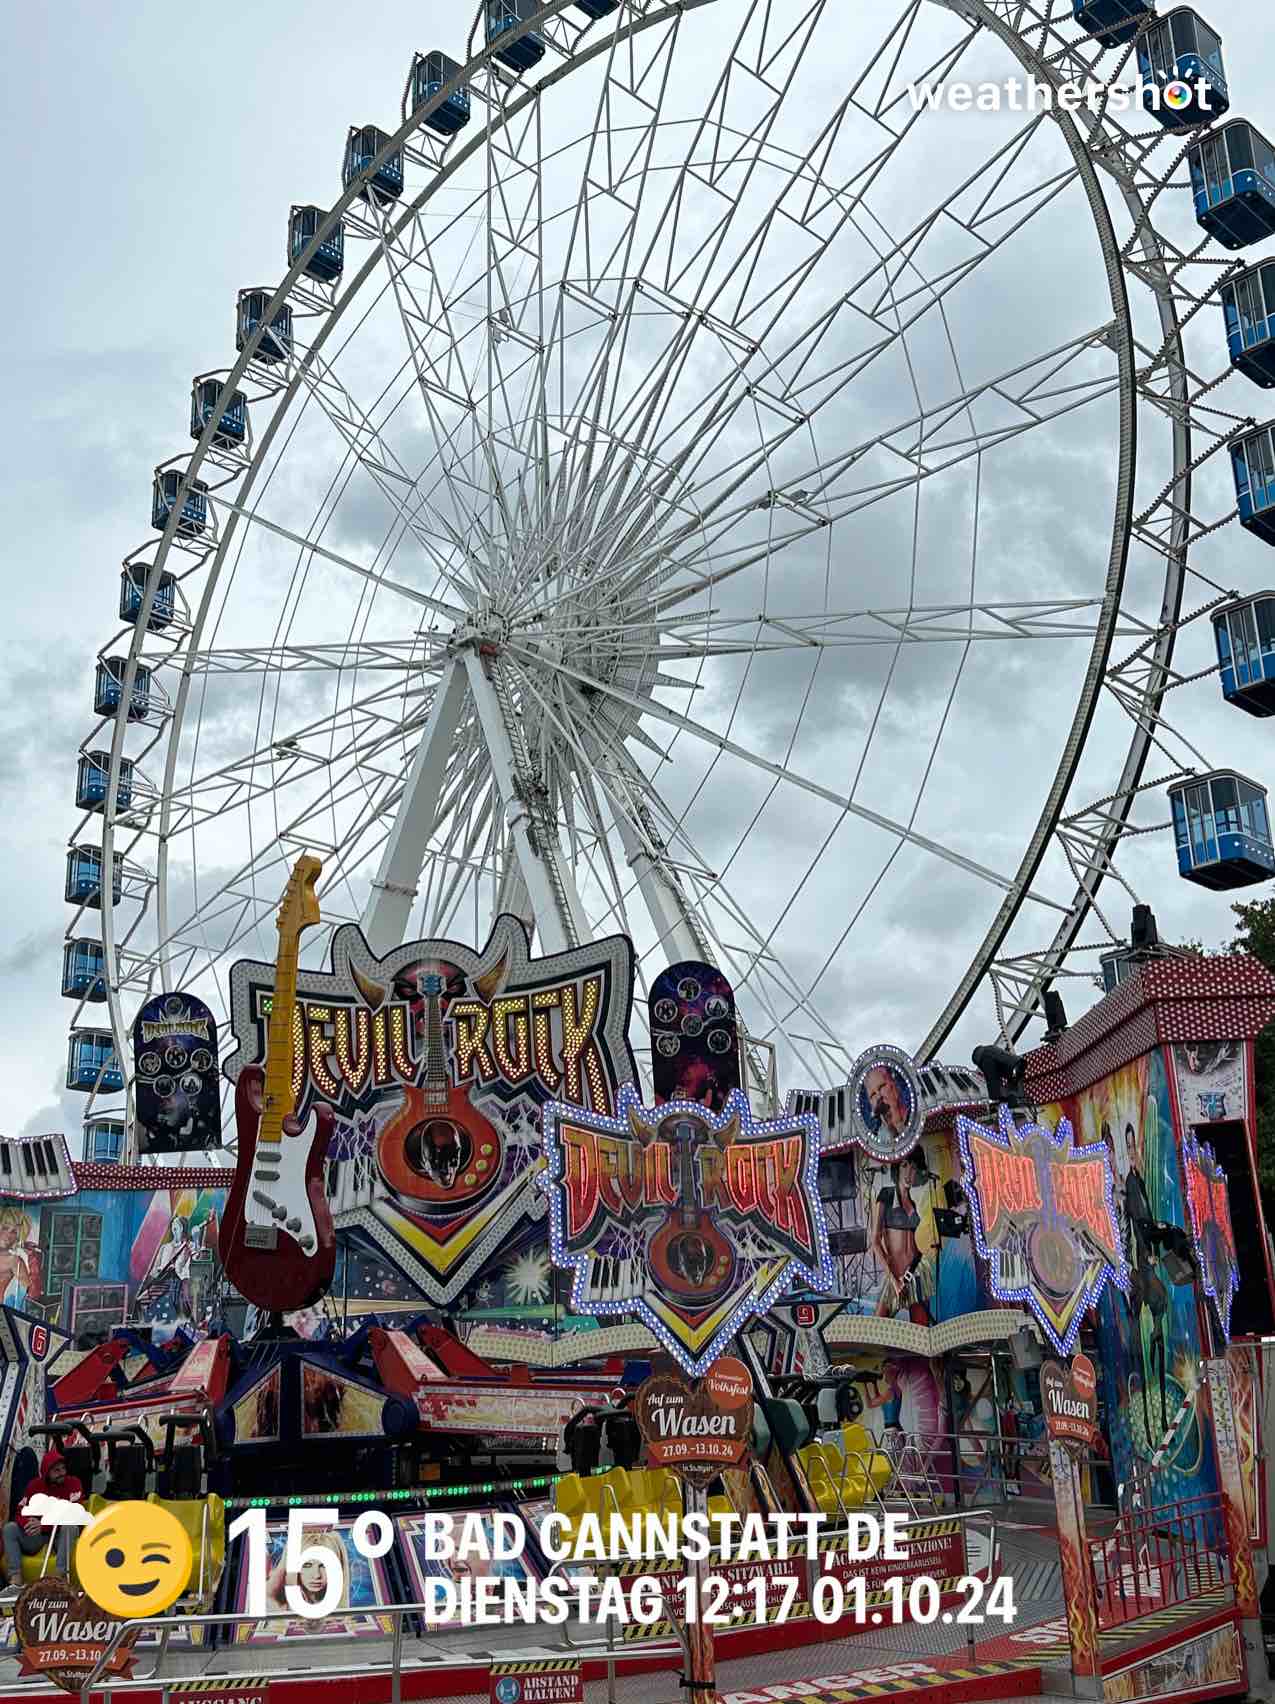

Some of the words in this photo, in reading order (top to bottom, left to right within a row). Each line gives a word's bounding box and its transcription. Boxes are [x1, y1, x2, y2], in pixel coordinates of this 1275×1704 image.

[559, 1123, 679, 1239] DEVIL
[696, 1134, 813, 1253] ROCK
[32, 1324, 48, 1357] 6
[646, 1392, 664, 1407] Auf
[665, 1395, 684, 1405] zum
[1048, 1389, 1090, 1419] Wasen
[651, 1407, 736, 1437] Wasen
[29, 1599, 48, 1611] Auf
[523, 1675, 579, 1689] ABSTAND
[524, 1686, 576, 1701] HALTEN!
[717, 1662, 937, 1704] ANGER
